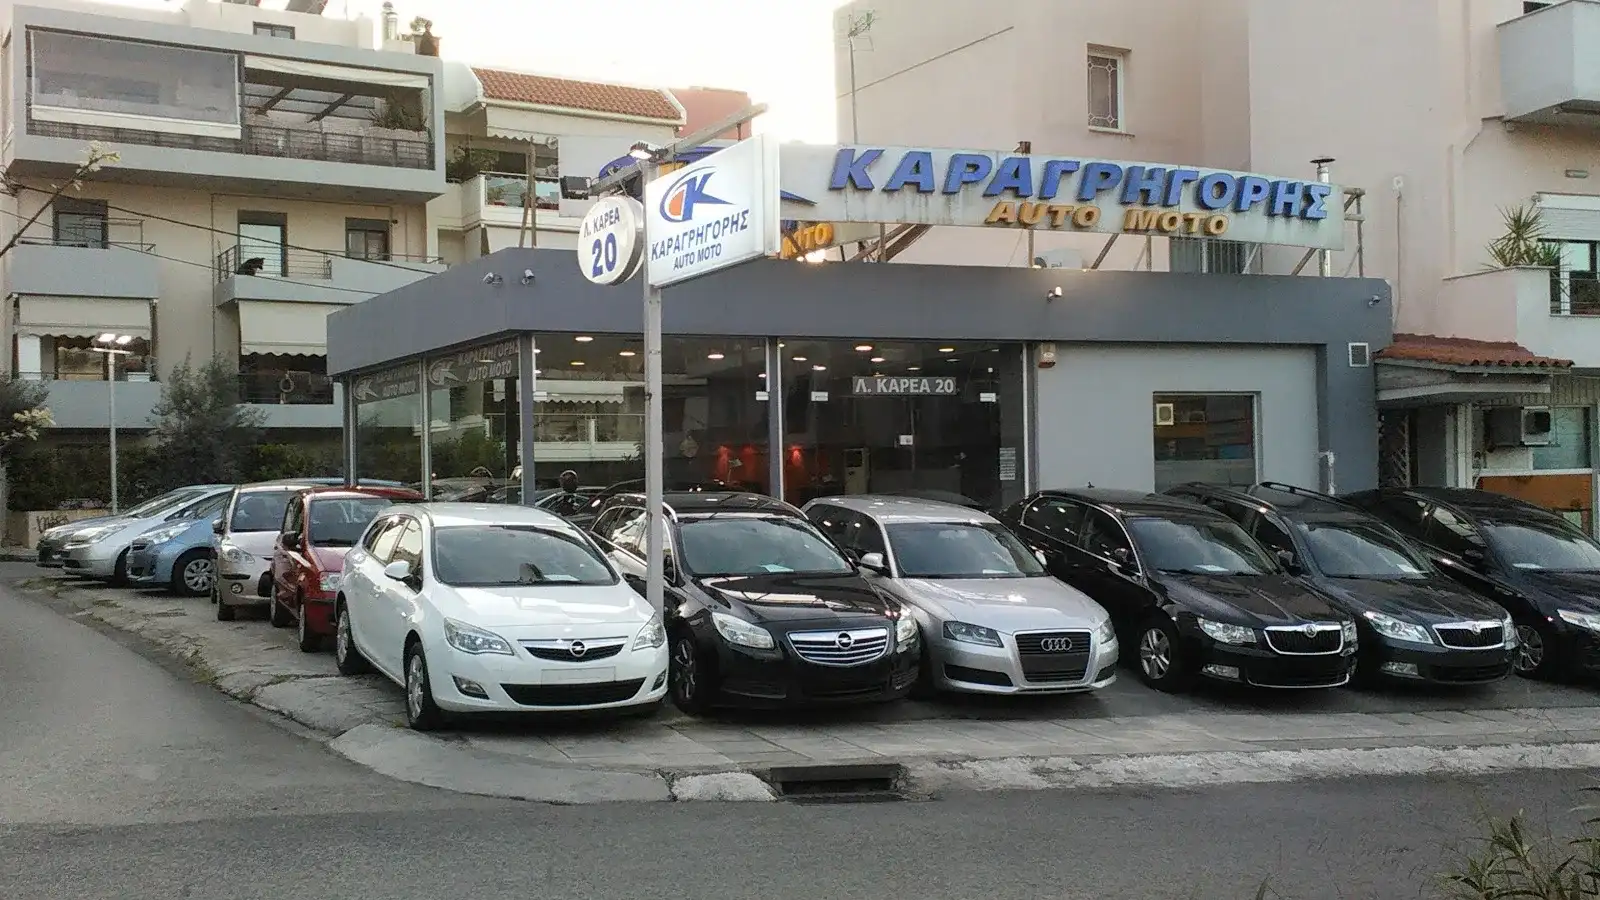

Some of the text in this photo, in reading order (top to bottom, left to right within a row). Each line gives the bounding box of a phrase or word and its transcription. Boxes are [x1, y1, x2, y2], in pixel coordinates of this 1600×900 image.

[829, 148, 1331, 220] ΚΑΡΑΓΡΗΓΟΡΗΣ
[593, 207, 620, 233] ΚΑΡΕΑ
[984, 200, 1230, 236] AUTO MOTO
[651, 209, 749, 261] ΚΑΡΑΓΡΗΓΟΡΗΣ
[591, 232, 617, 278] 20
[673, 243, 722, 271] AUTO MOTO
[466, 360, 512, 382] AUTO MOTO
[855, 379, 954, 393] Λ. ΚΑΡΕΑ 20
